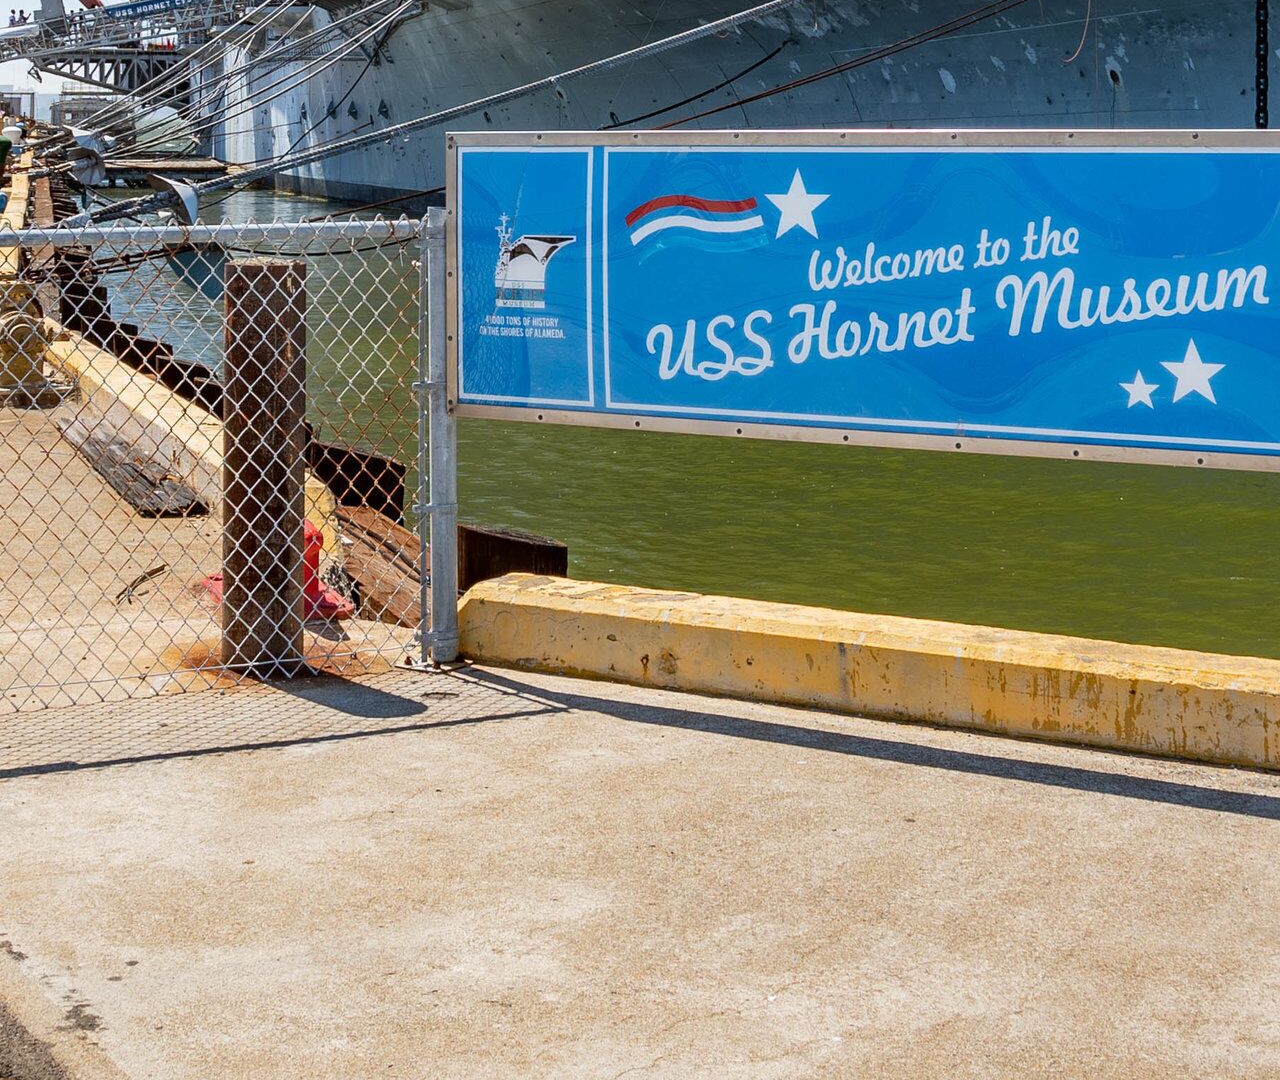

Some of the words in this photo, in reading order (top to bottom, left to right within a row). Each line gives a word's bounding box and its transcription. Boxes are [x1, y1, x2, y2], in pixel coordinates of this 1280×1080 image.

[115, 8, 133, 18] USS
[136, 0, 171, 14] HORNET
[808, 241, 965, 291] Welcome
[973, 228, 1010, 269] to
[1019, 216, 1080, 261] the
[506, 316, 521, 325] TONS
[523, 317, 531, 326] OF
[532, 317, 559, 327] HISTORY
[646, 309, 774, 381] USS
[787, 288, 976, 364] Hornet
[995, 265, 1270, 337] Museum
[488, 327, 499, 336] THE
[500, 327, 524, 336] SHORES
[525, 328, 533, 337] OF
